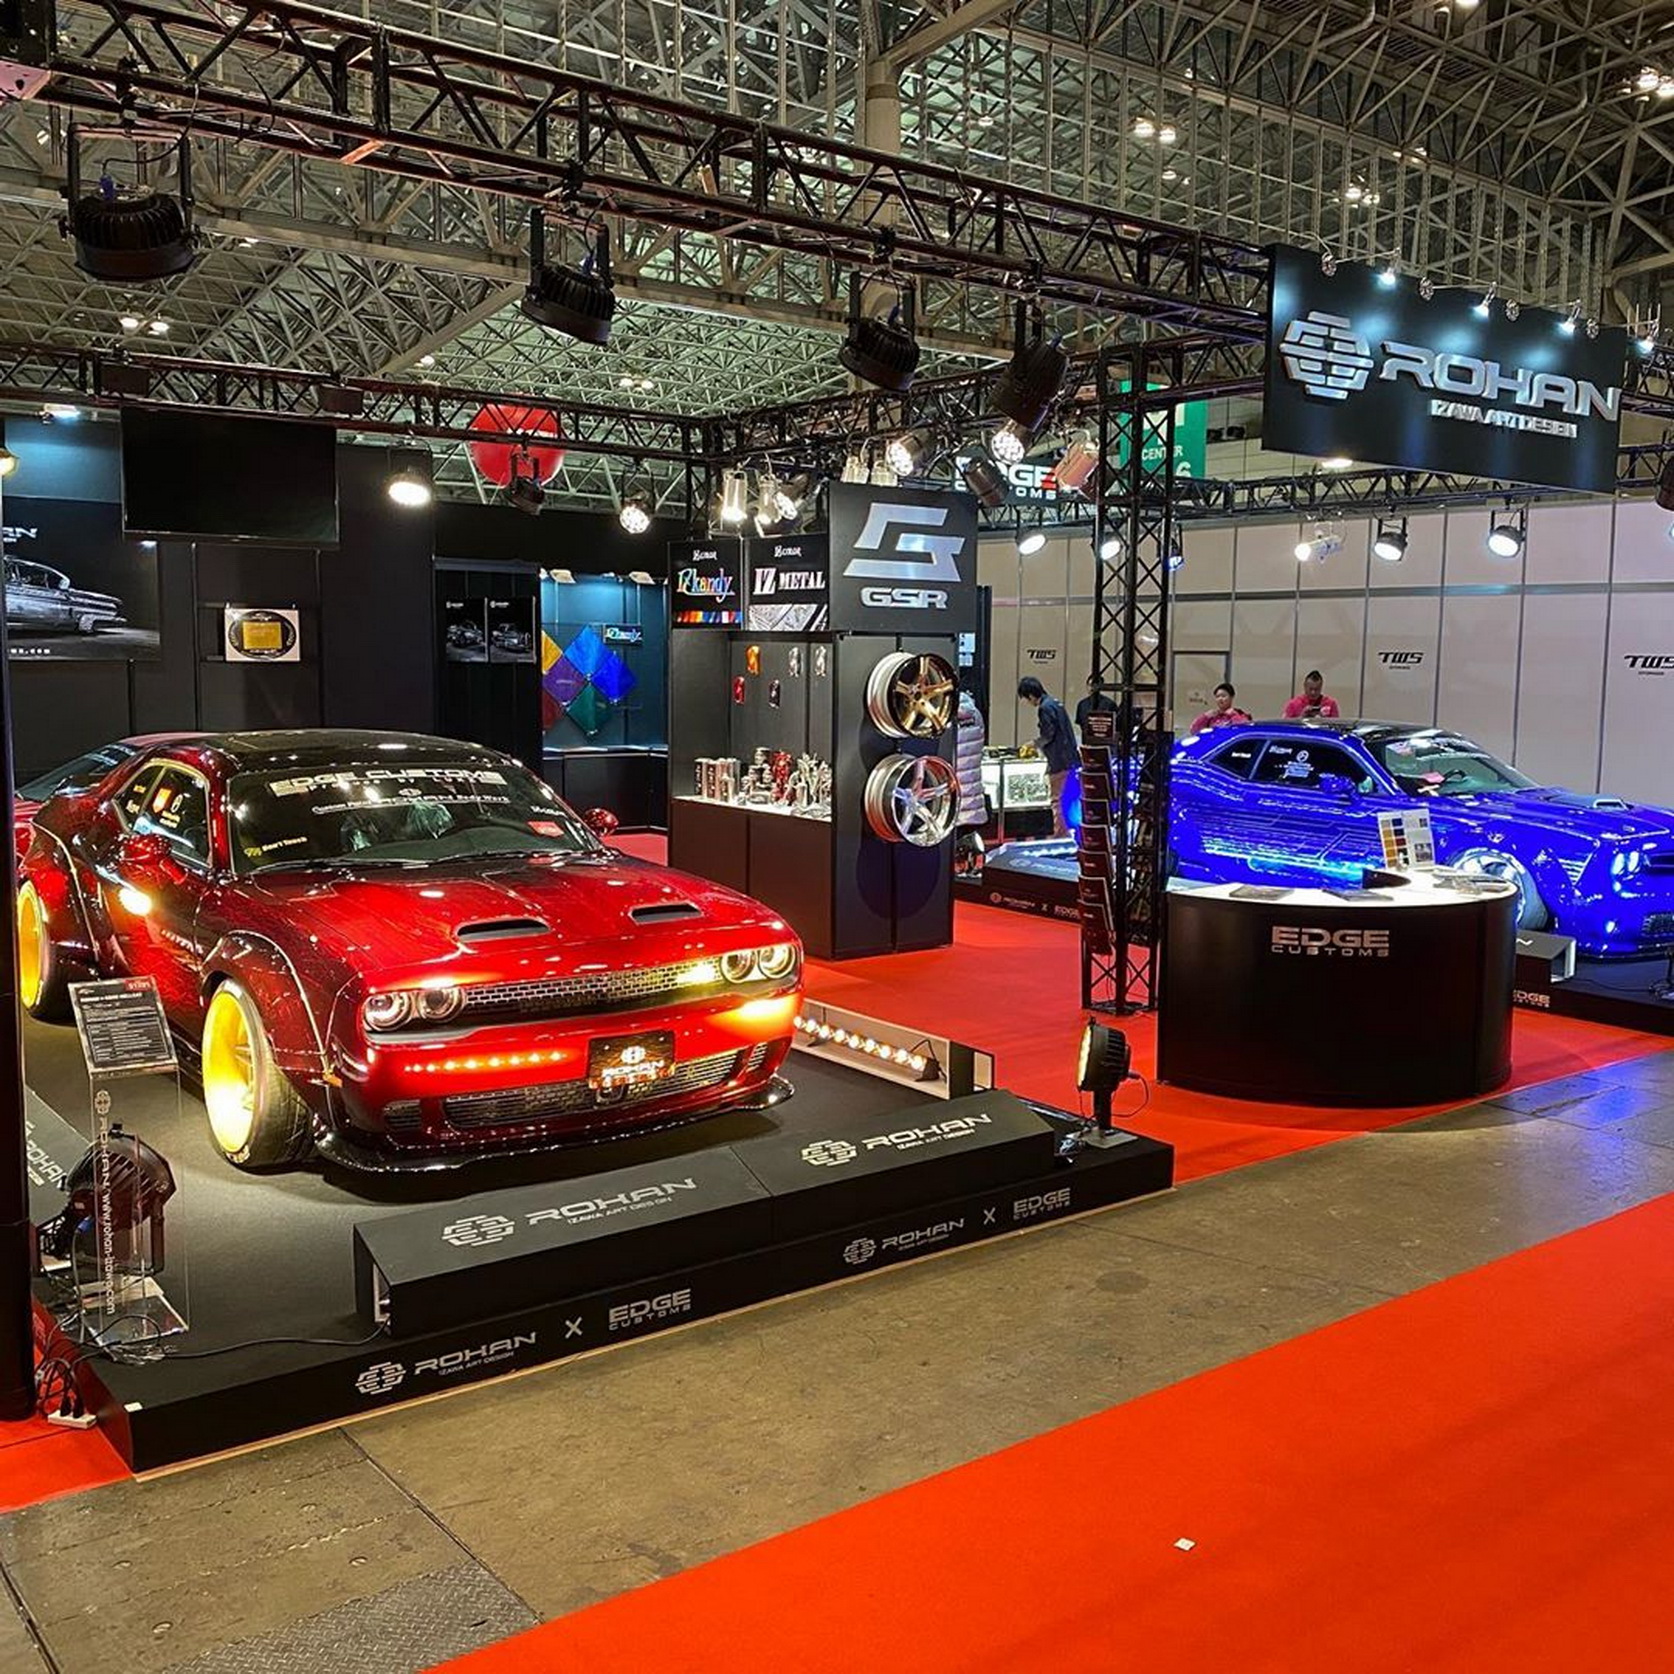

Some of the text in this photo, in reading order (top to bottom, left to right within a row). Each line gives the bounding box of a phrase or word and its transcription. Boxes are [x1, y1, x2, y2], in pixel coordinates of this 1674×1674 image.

[1380, 340, 1622, 422] ROHAN
[778, 571, 826, 591] METAL
[860, 586, 949, 609] GSR
[1378, 651, 1424, 664] TWS
[1271, 925, 1390, 948] EDGE
[1271, 944, 1390, 958] CUSTOMS
[861, 1113, 993, 1151] ROHAN
[525, 1177, 698, 1226] ROHAN
[881, 1217, 965, 1250] ROHAN
[1013, 1187, 1071, 1213] EDGE
[608, 1303, 692, 1331] CUSTOMS
[414, 1331, 538, 1376] ROHAN
[608, 1288, 692, 1323] EDGE
